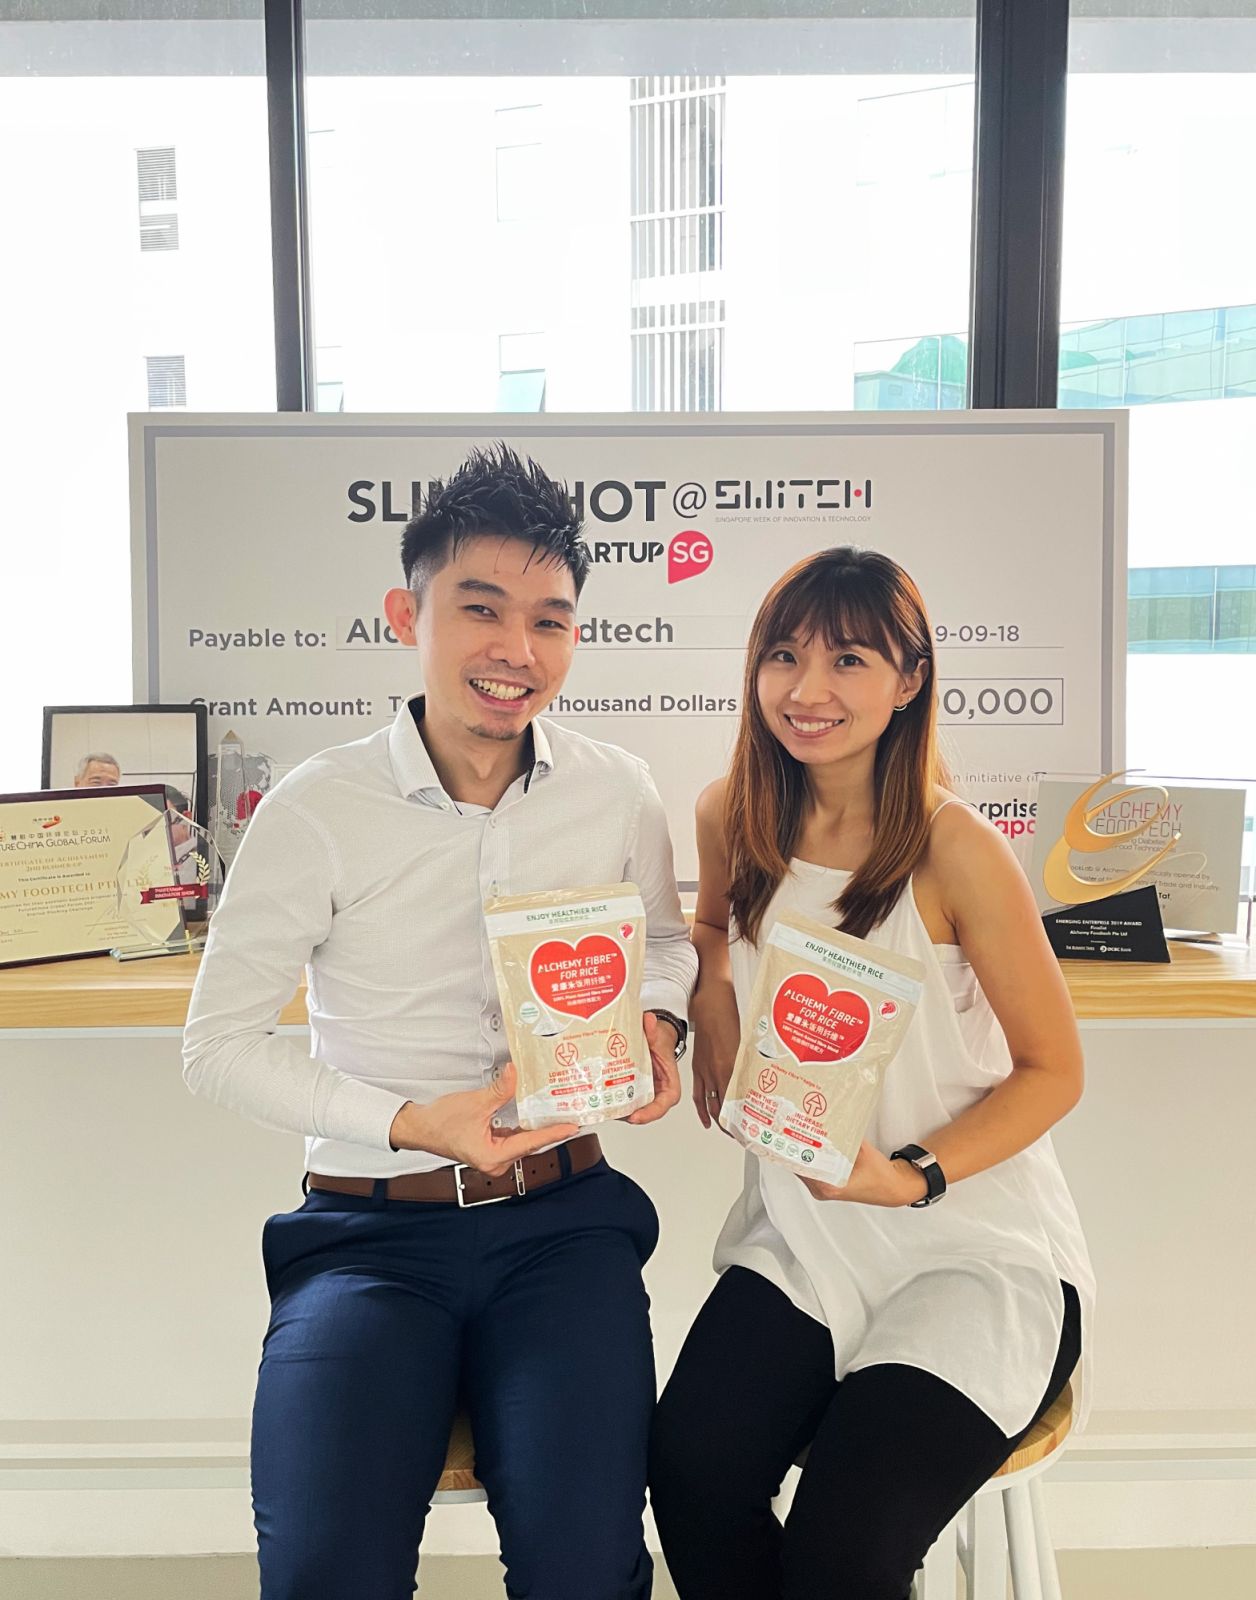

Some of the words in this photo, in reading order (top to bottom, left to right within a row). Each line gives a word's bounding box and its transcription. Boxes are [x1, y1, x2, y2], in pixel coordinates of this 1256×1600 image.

[347, 480, 666, 523] SLIHOT
[673, 482, 707, 518] @
[673, 541, 710, 564] SG
[189, 628, 286, 650] Payable
[294, 629, 326, 647] to:
[579, 617, 674, 643] dtech
[935, 625, 1020, 642] 9-09-18
[266, 697, 373, 716] Amount:
[660, 694, 737, 712] Dollars
[938, 688, 1053, 720] 0,000
[966, 771, 1022, 783] initiative
[80, 835, 111, 845] FORUM
[23, 883, 94, 898] FOODTECH
[526, 912, 550, 922] ENJOY
[551, 907, 590, 918] HEALTHIER
[591, 905, 608, 913] RICE
[537, 958, 583, 974] ALCHEMY
[805, 941, 829, 956] ENJOY
[828, 949, 867, 972] HEALTHIER
[867, 967, 884, 980] RICE
[560, 970, 578, 980] FOR
[580, 966, 599, 977] RICE
[783, 989, 829, 1013] ALCHEMY
[799, 1006, 818, 1020] FOR
[817, 1015, 839, 1030] RICE
